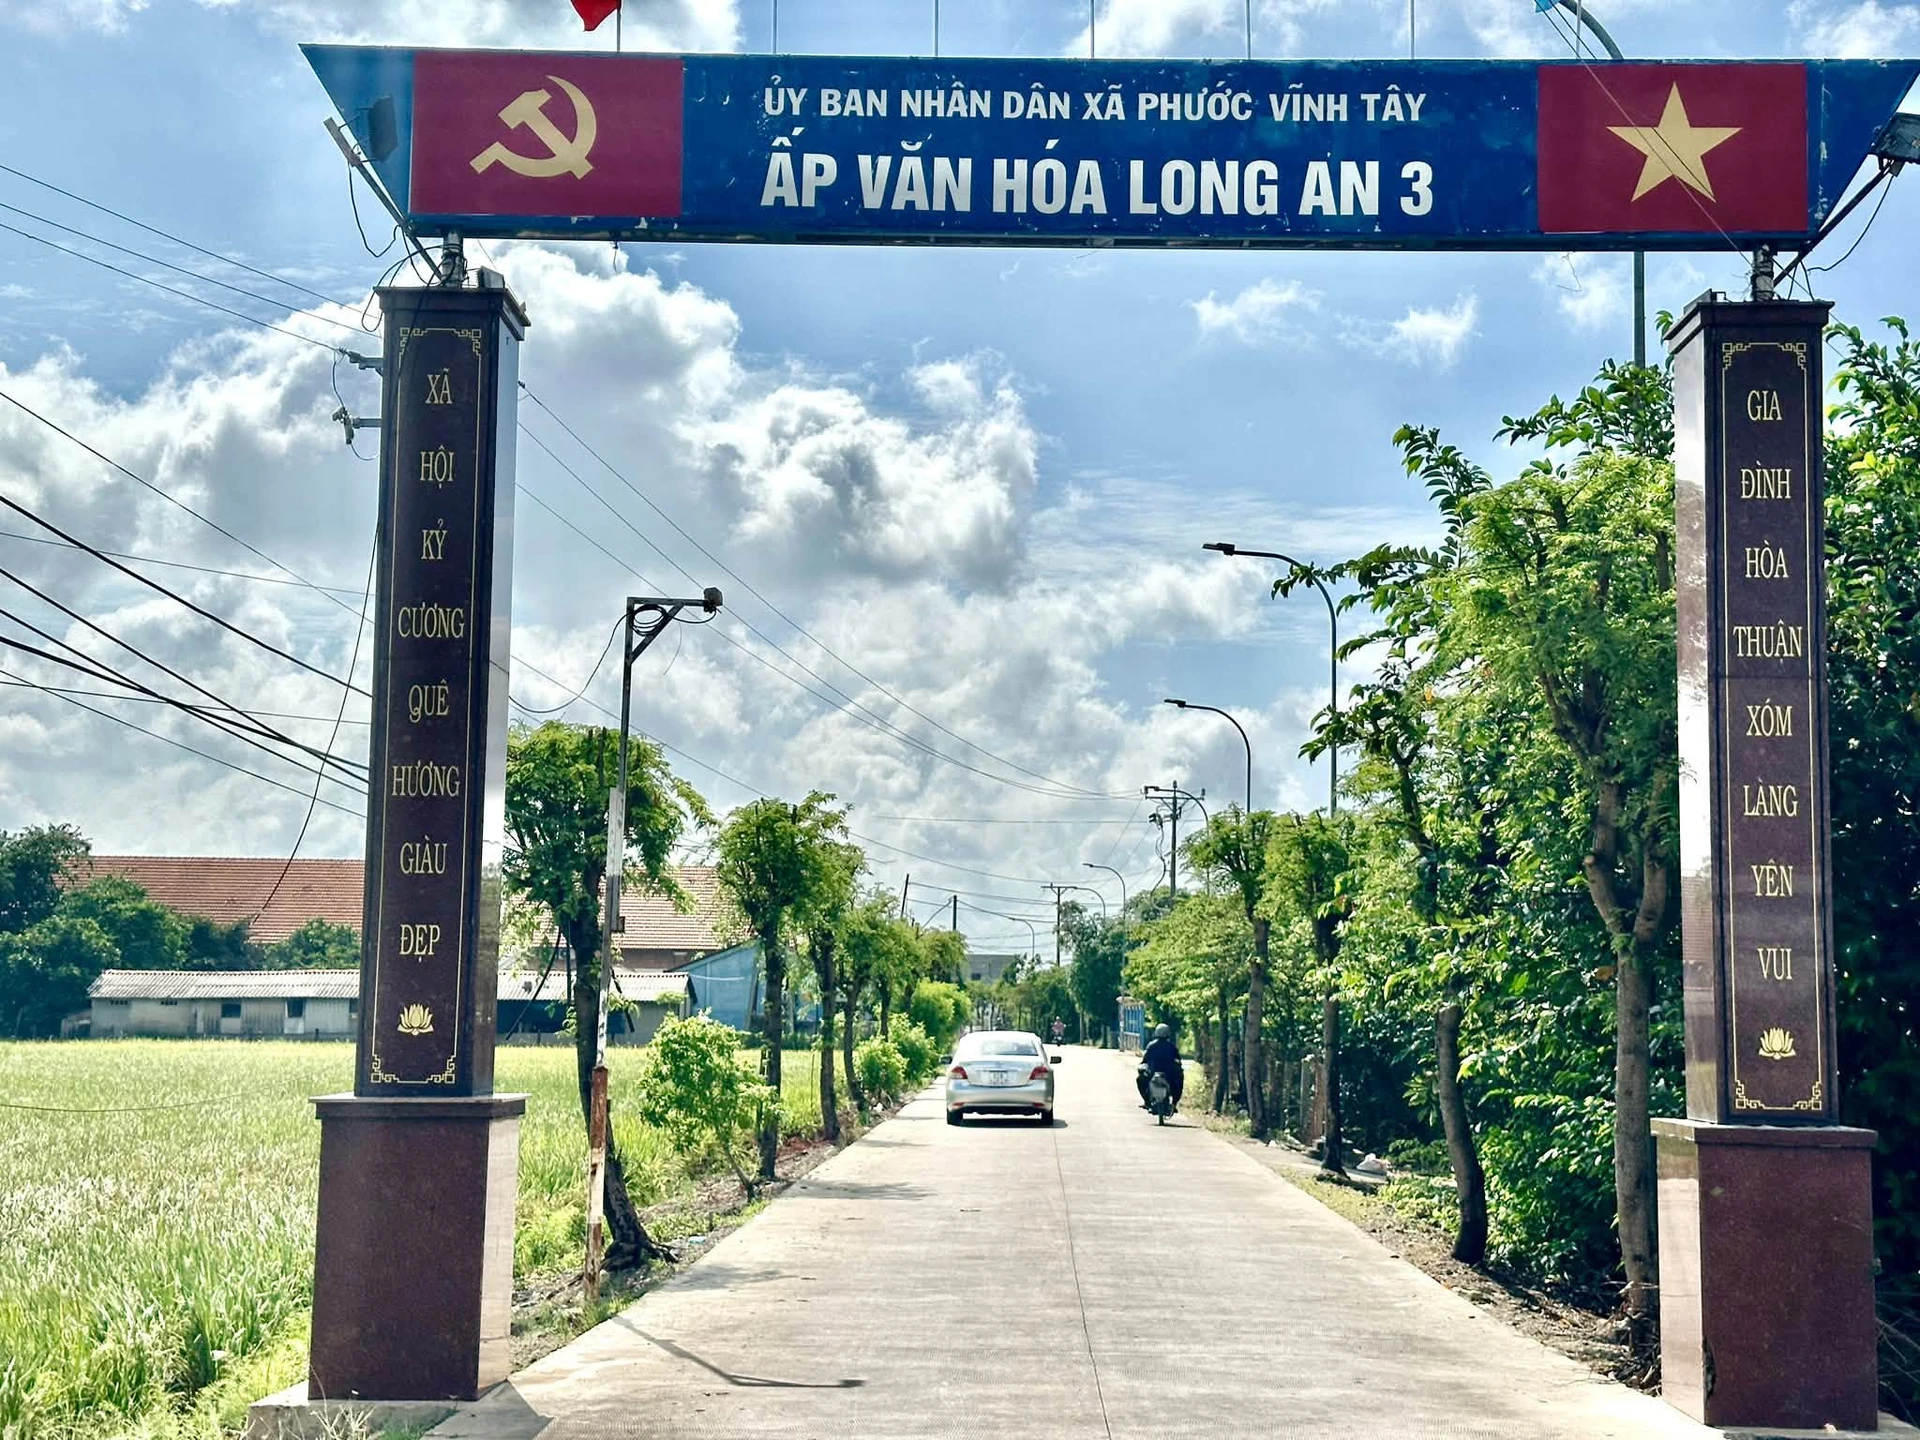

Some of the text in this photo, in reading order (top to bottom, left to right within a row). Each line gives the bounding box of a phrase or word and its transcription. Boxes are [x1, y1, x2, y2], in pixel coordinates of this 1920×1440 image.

[761, 127, 1432, 215] ẤP VĂN HÓA LONG AN 3
[764, 75, 1426, 121] ỦY BAN NHÂN DÂN XÃ PHƯỚC VĨNH TÂY
[392, 368, 464, 962] XÃ HỘI KỶ CƯƠNG QUÊ HƯƠNG GIÀU ĐẸP
[1733, 390, 1802, 980] GIA ĐÌNH HÒA THUẬN XÓM LÀNG YÊN VUI
